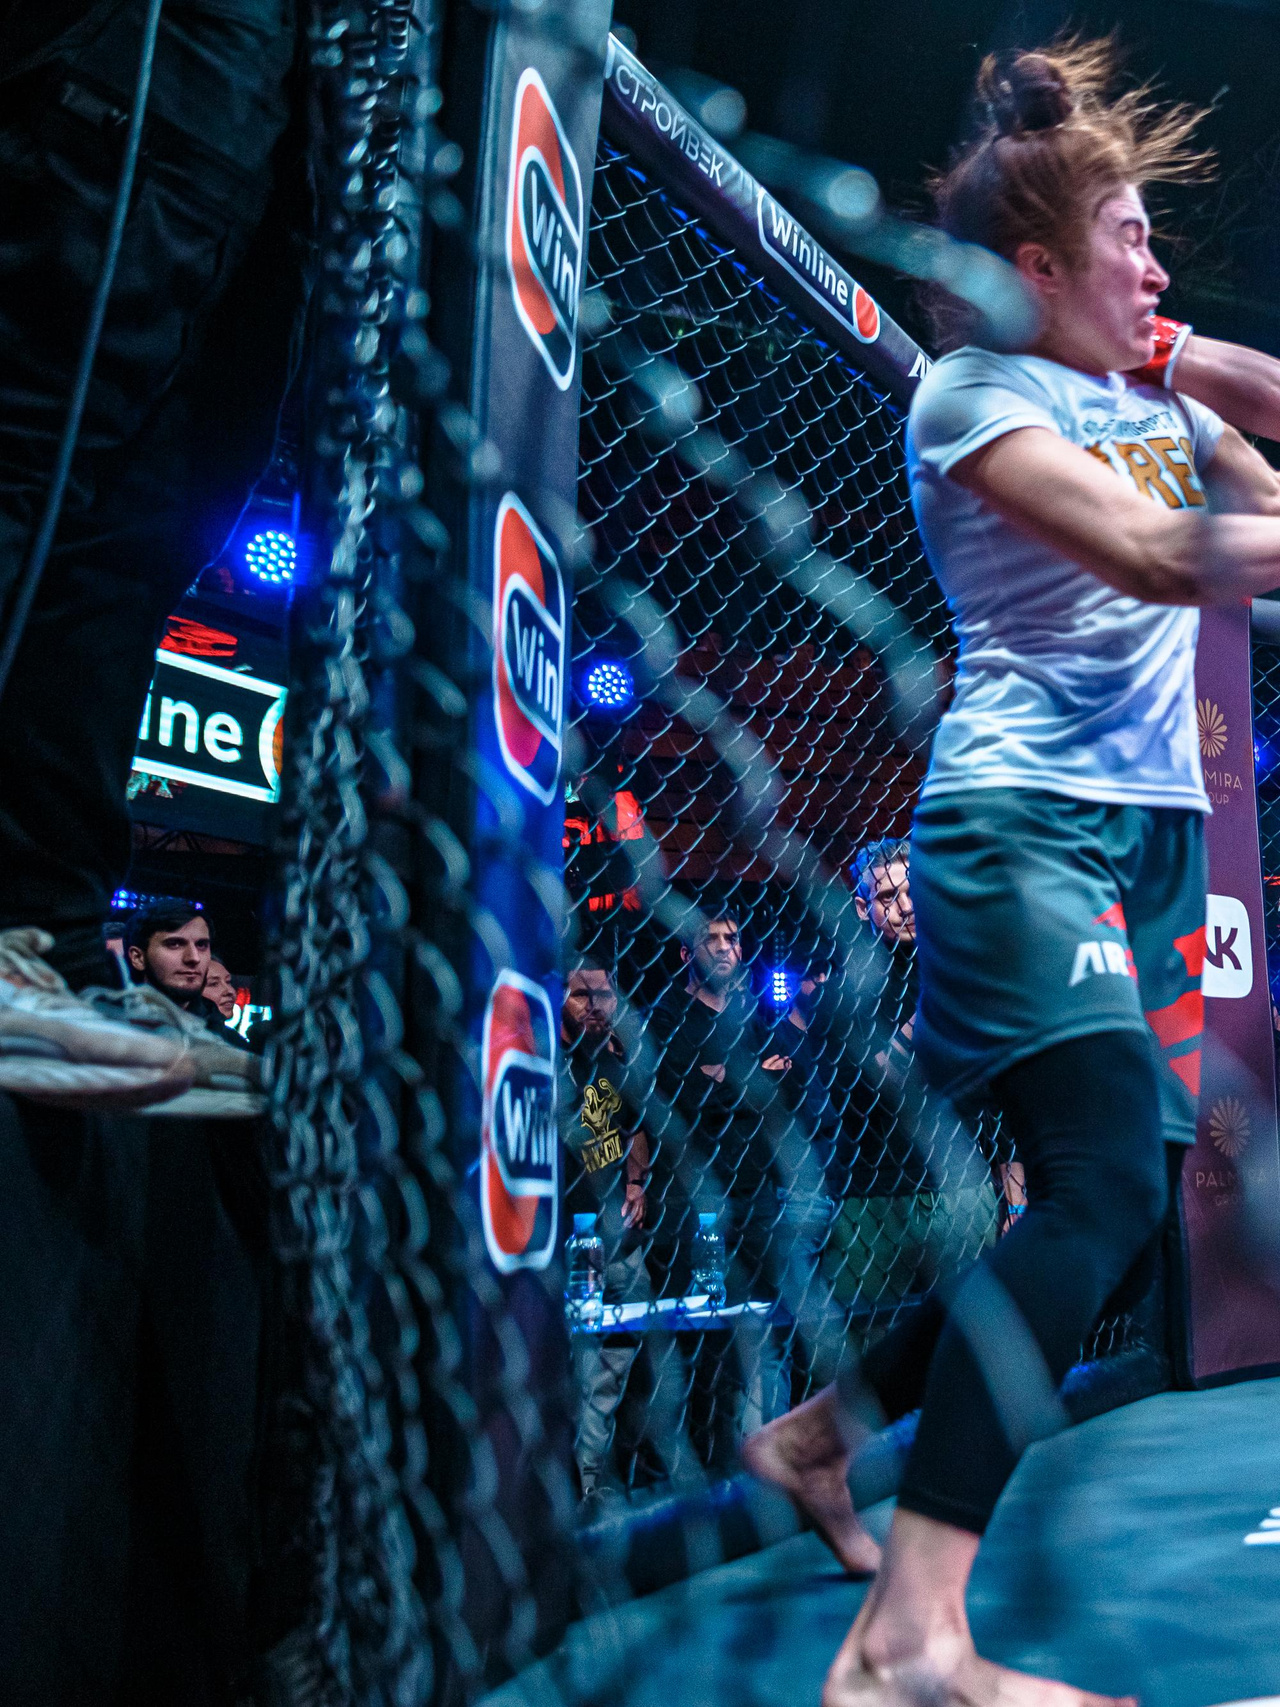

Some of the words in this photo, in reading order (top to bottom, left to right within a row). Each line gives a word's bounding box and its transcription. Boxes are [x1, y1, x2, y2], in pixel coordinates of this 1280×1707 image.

[616, 64, 723, 187] СТРОЙВЕК
[531, 169, 576, 318] Win
[770, 202, 849, 306] Winline
[511, 597, 559, 721] Win
